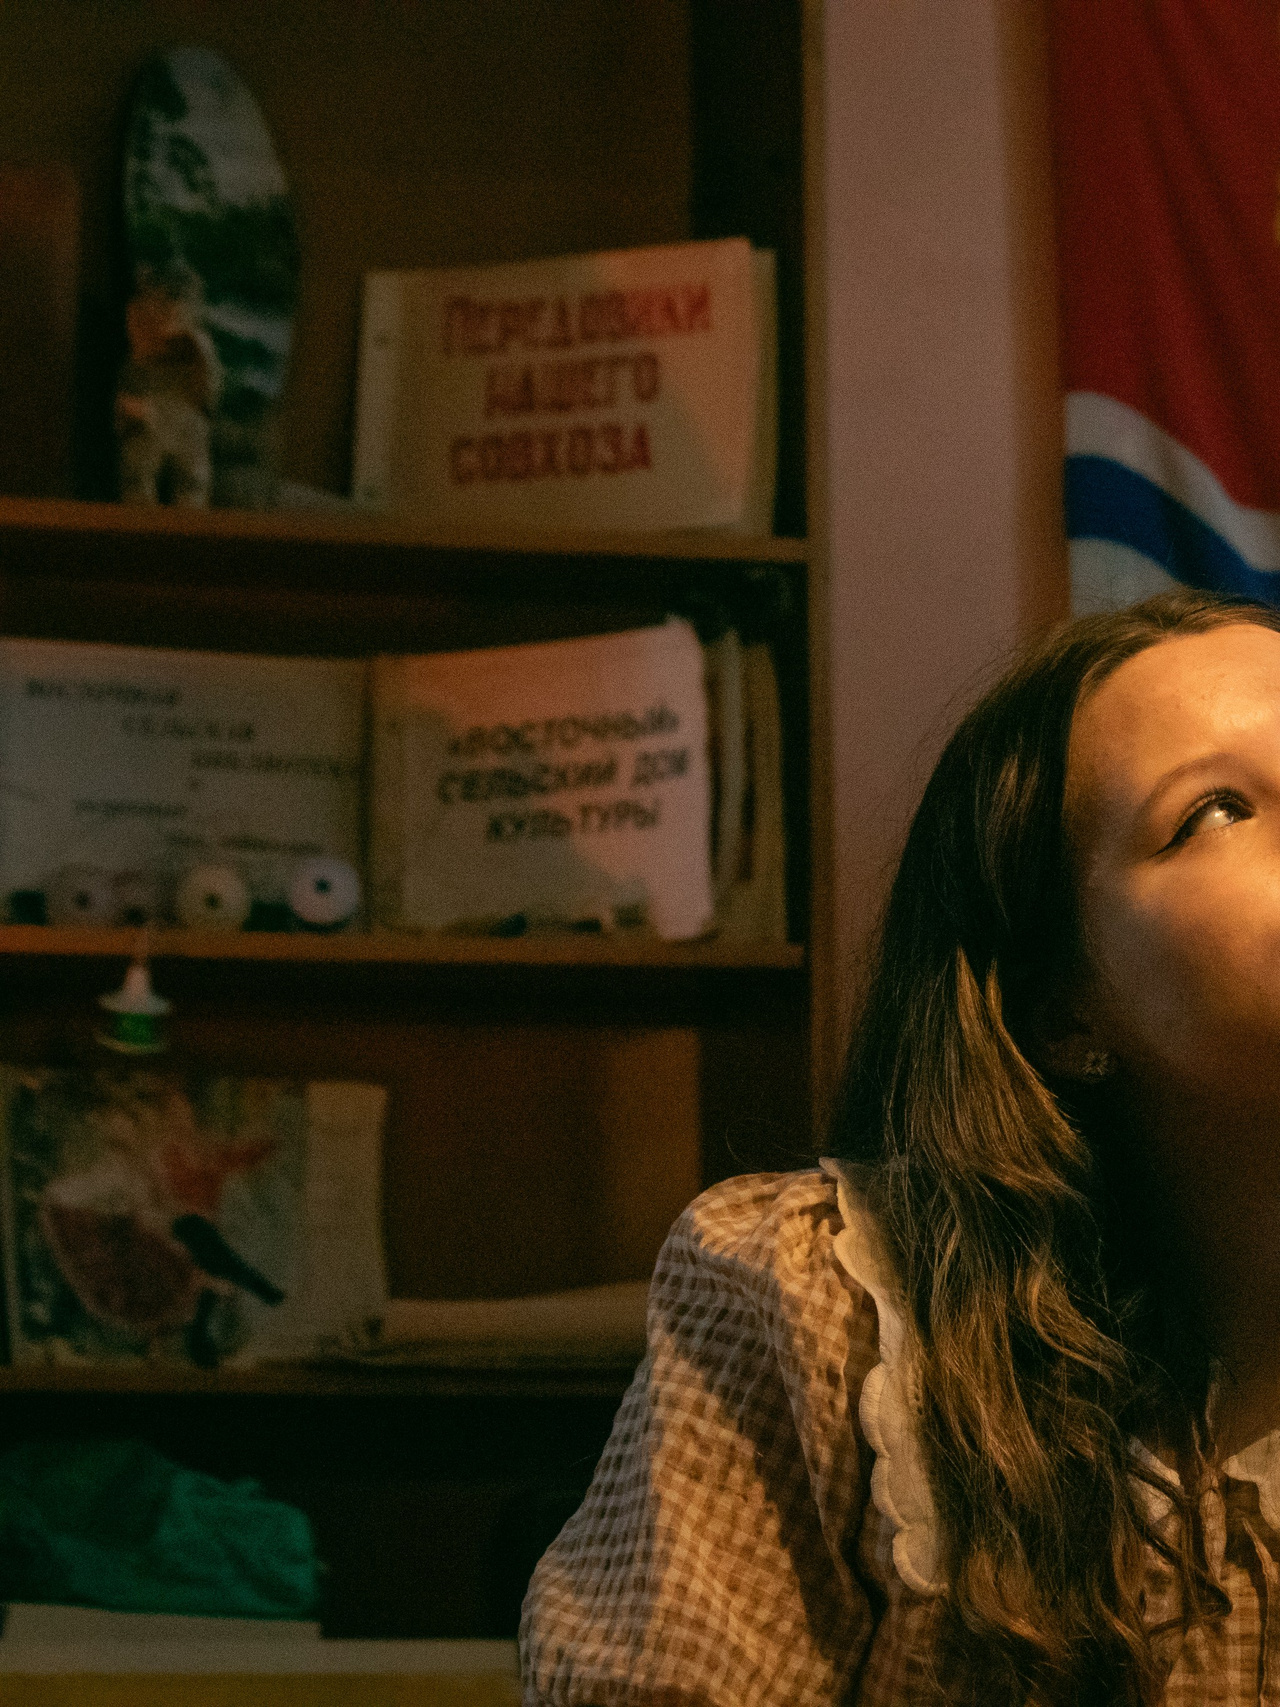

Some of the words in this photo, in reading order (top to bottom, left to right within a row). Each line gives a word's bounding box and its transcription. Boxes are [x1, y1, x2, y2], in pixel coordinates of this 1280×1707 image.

[442, 285, 712, 356] ПЕРЕДОВИКИ
[483, 351, 661, 420] НАШЕГО
[452, 424, 652, 487] СОВХОЗА
[485, 800, 661, 843] КУЛЬТУРЫ
